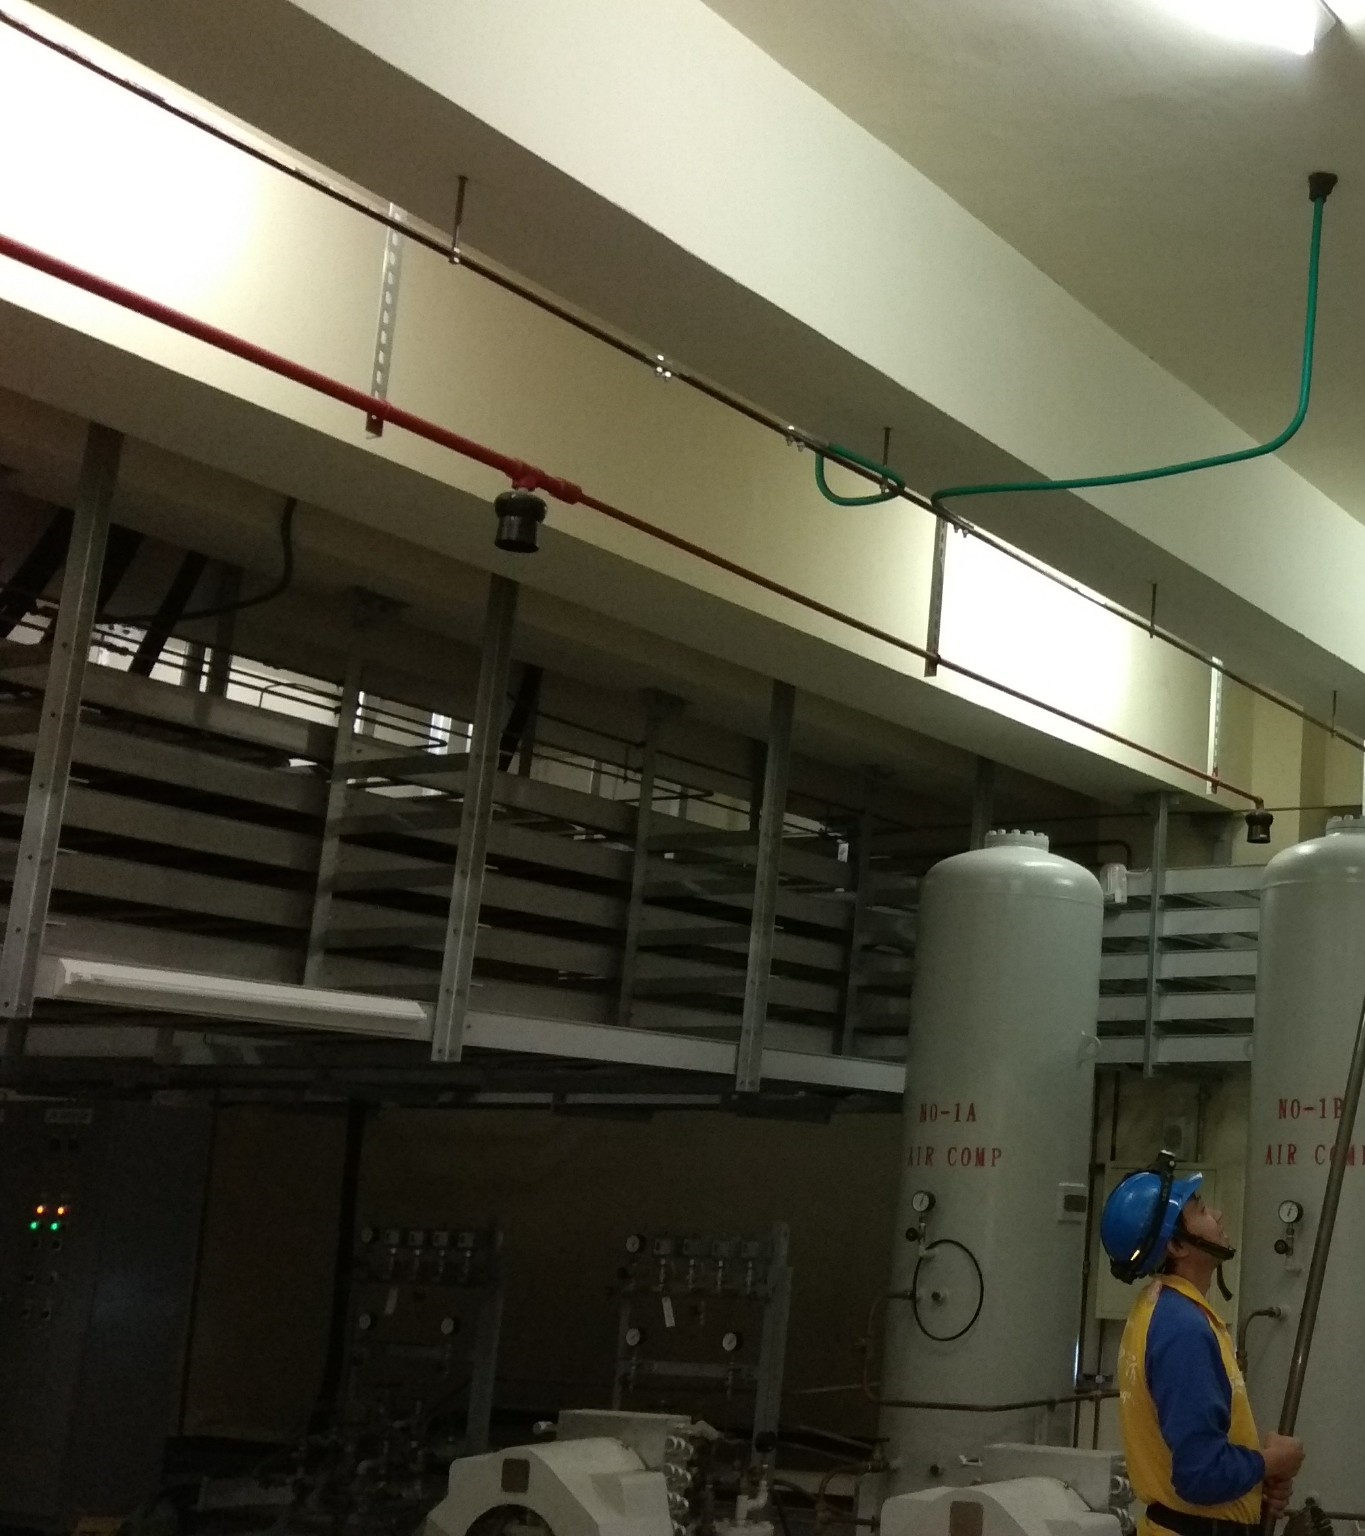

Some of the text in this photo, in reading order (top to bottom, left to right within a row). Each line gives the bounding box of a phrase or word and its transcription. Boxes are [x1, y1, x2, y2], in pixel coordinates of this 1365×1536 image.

[920, 1103, 976, 1123] NO-1A
[1278, 1098, 1345, 1119] NO-1B
[907, 1146, 1002, 1167] AIR COMP
[1265, 1144, 1297, 1165] AIR
